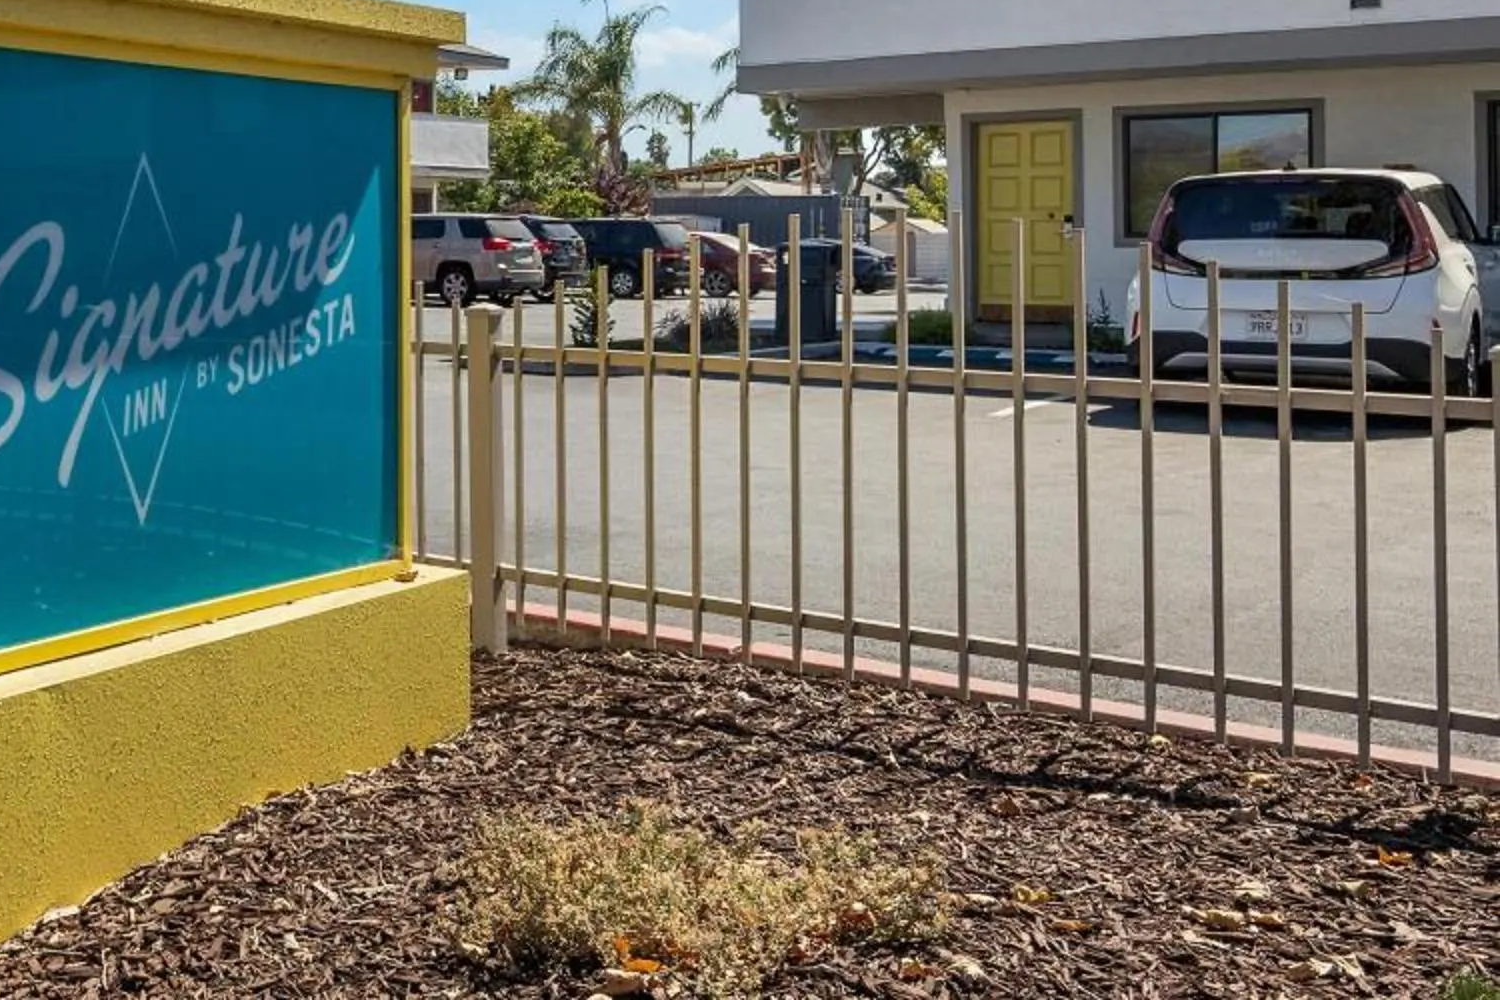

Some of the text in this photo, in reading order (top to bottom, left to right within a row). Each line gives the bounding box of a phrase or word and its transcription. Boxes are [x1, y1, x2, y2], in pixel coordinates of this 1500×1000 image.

[123, 293, 356, 437] INN BY SONESTA
